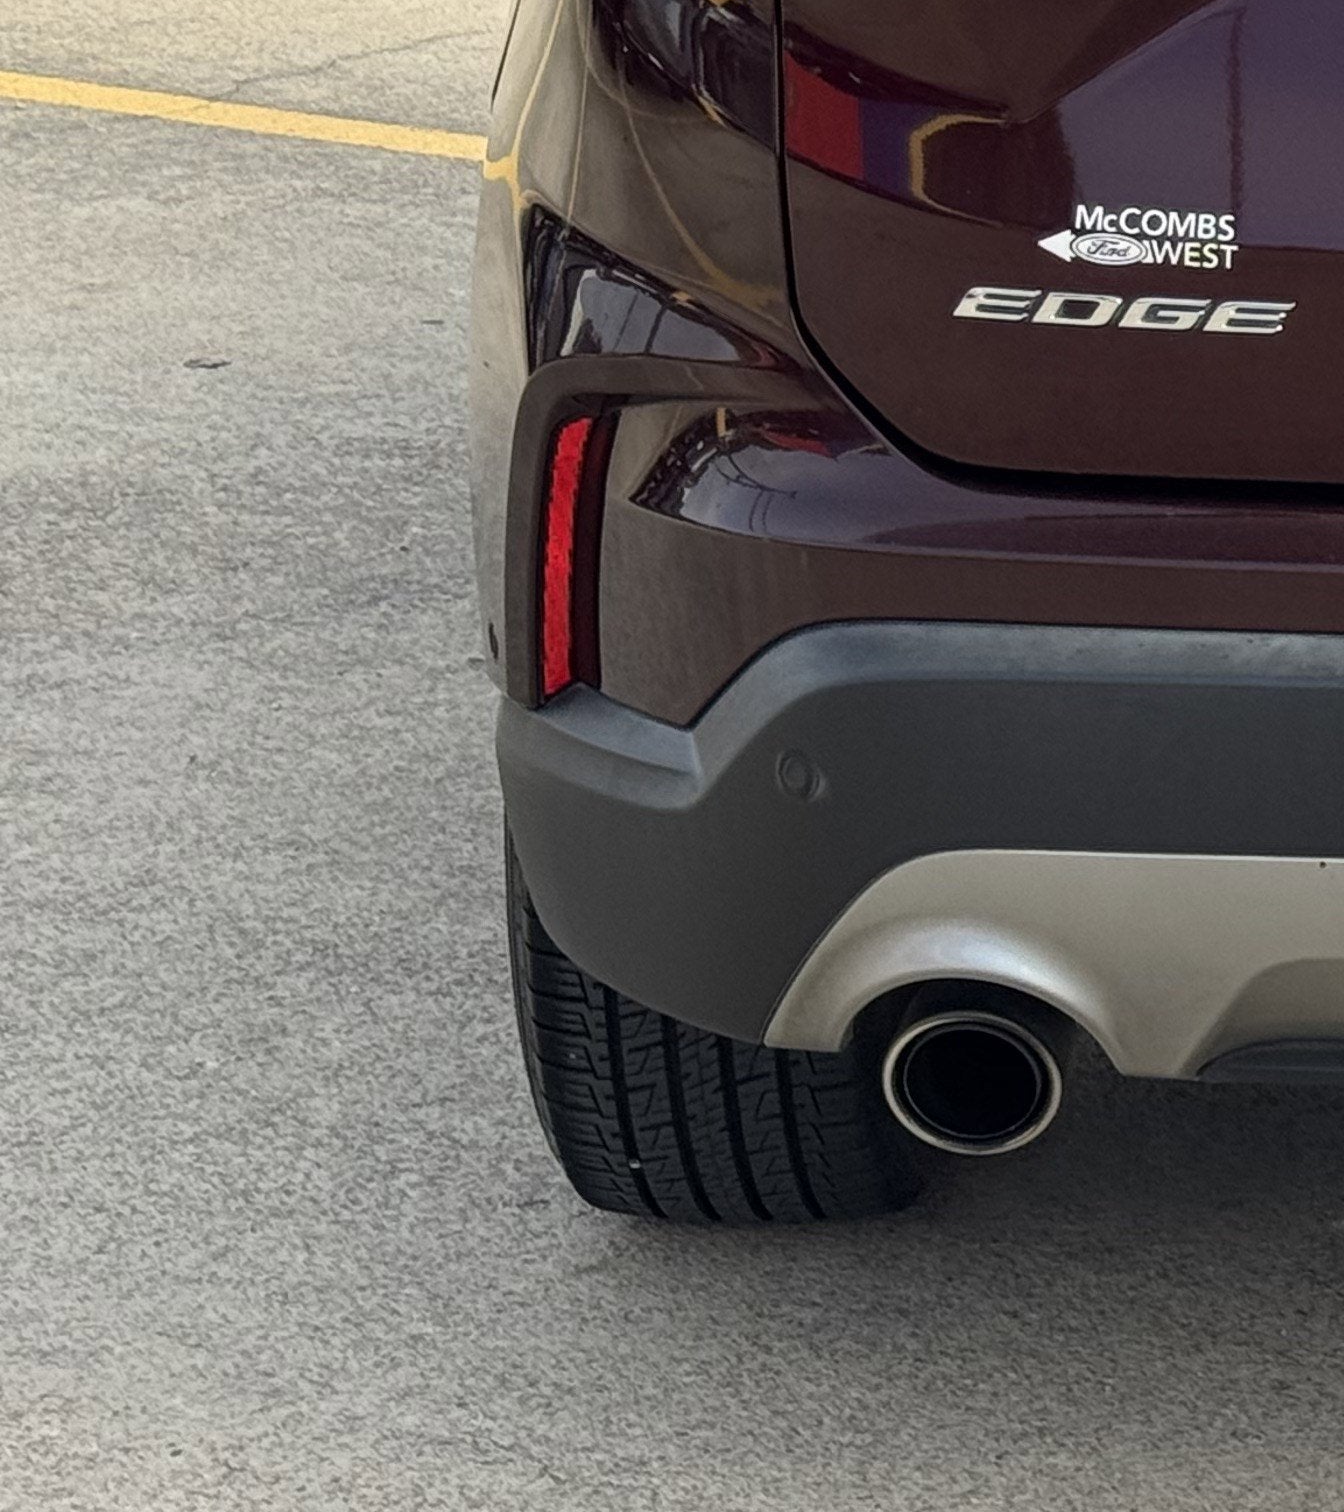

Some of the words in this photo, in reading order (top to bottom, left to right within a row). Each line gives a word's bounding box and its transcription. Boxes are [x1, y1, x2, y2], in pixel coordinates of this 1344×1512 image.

[1074, 204, 1236, 242] McCOMBS
[1150, 240, 1239, 270] WEST
[952, 286, 1297, 335] EDGE
